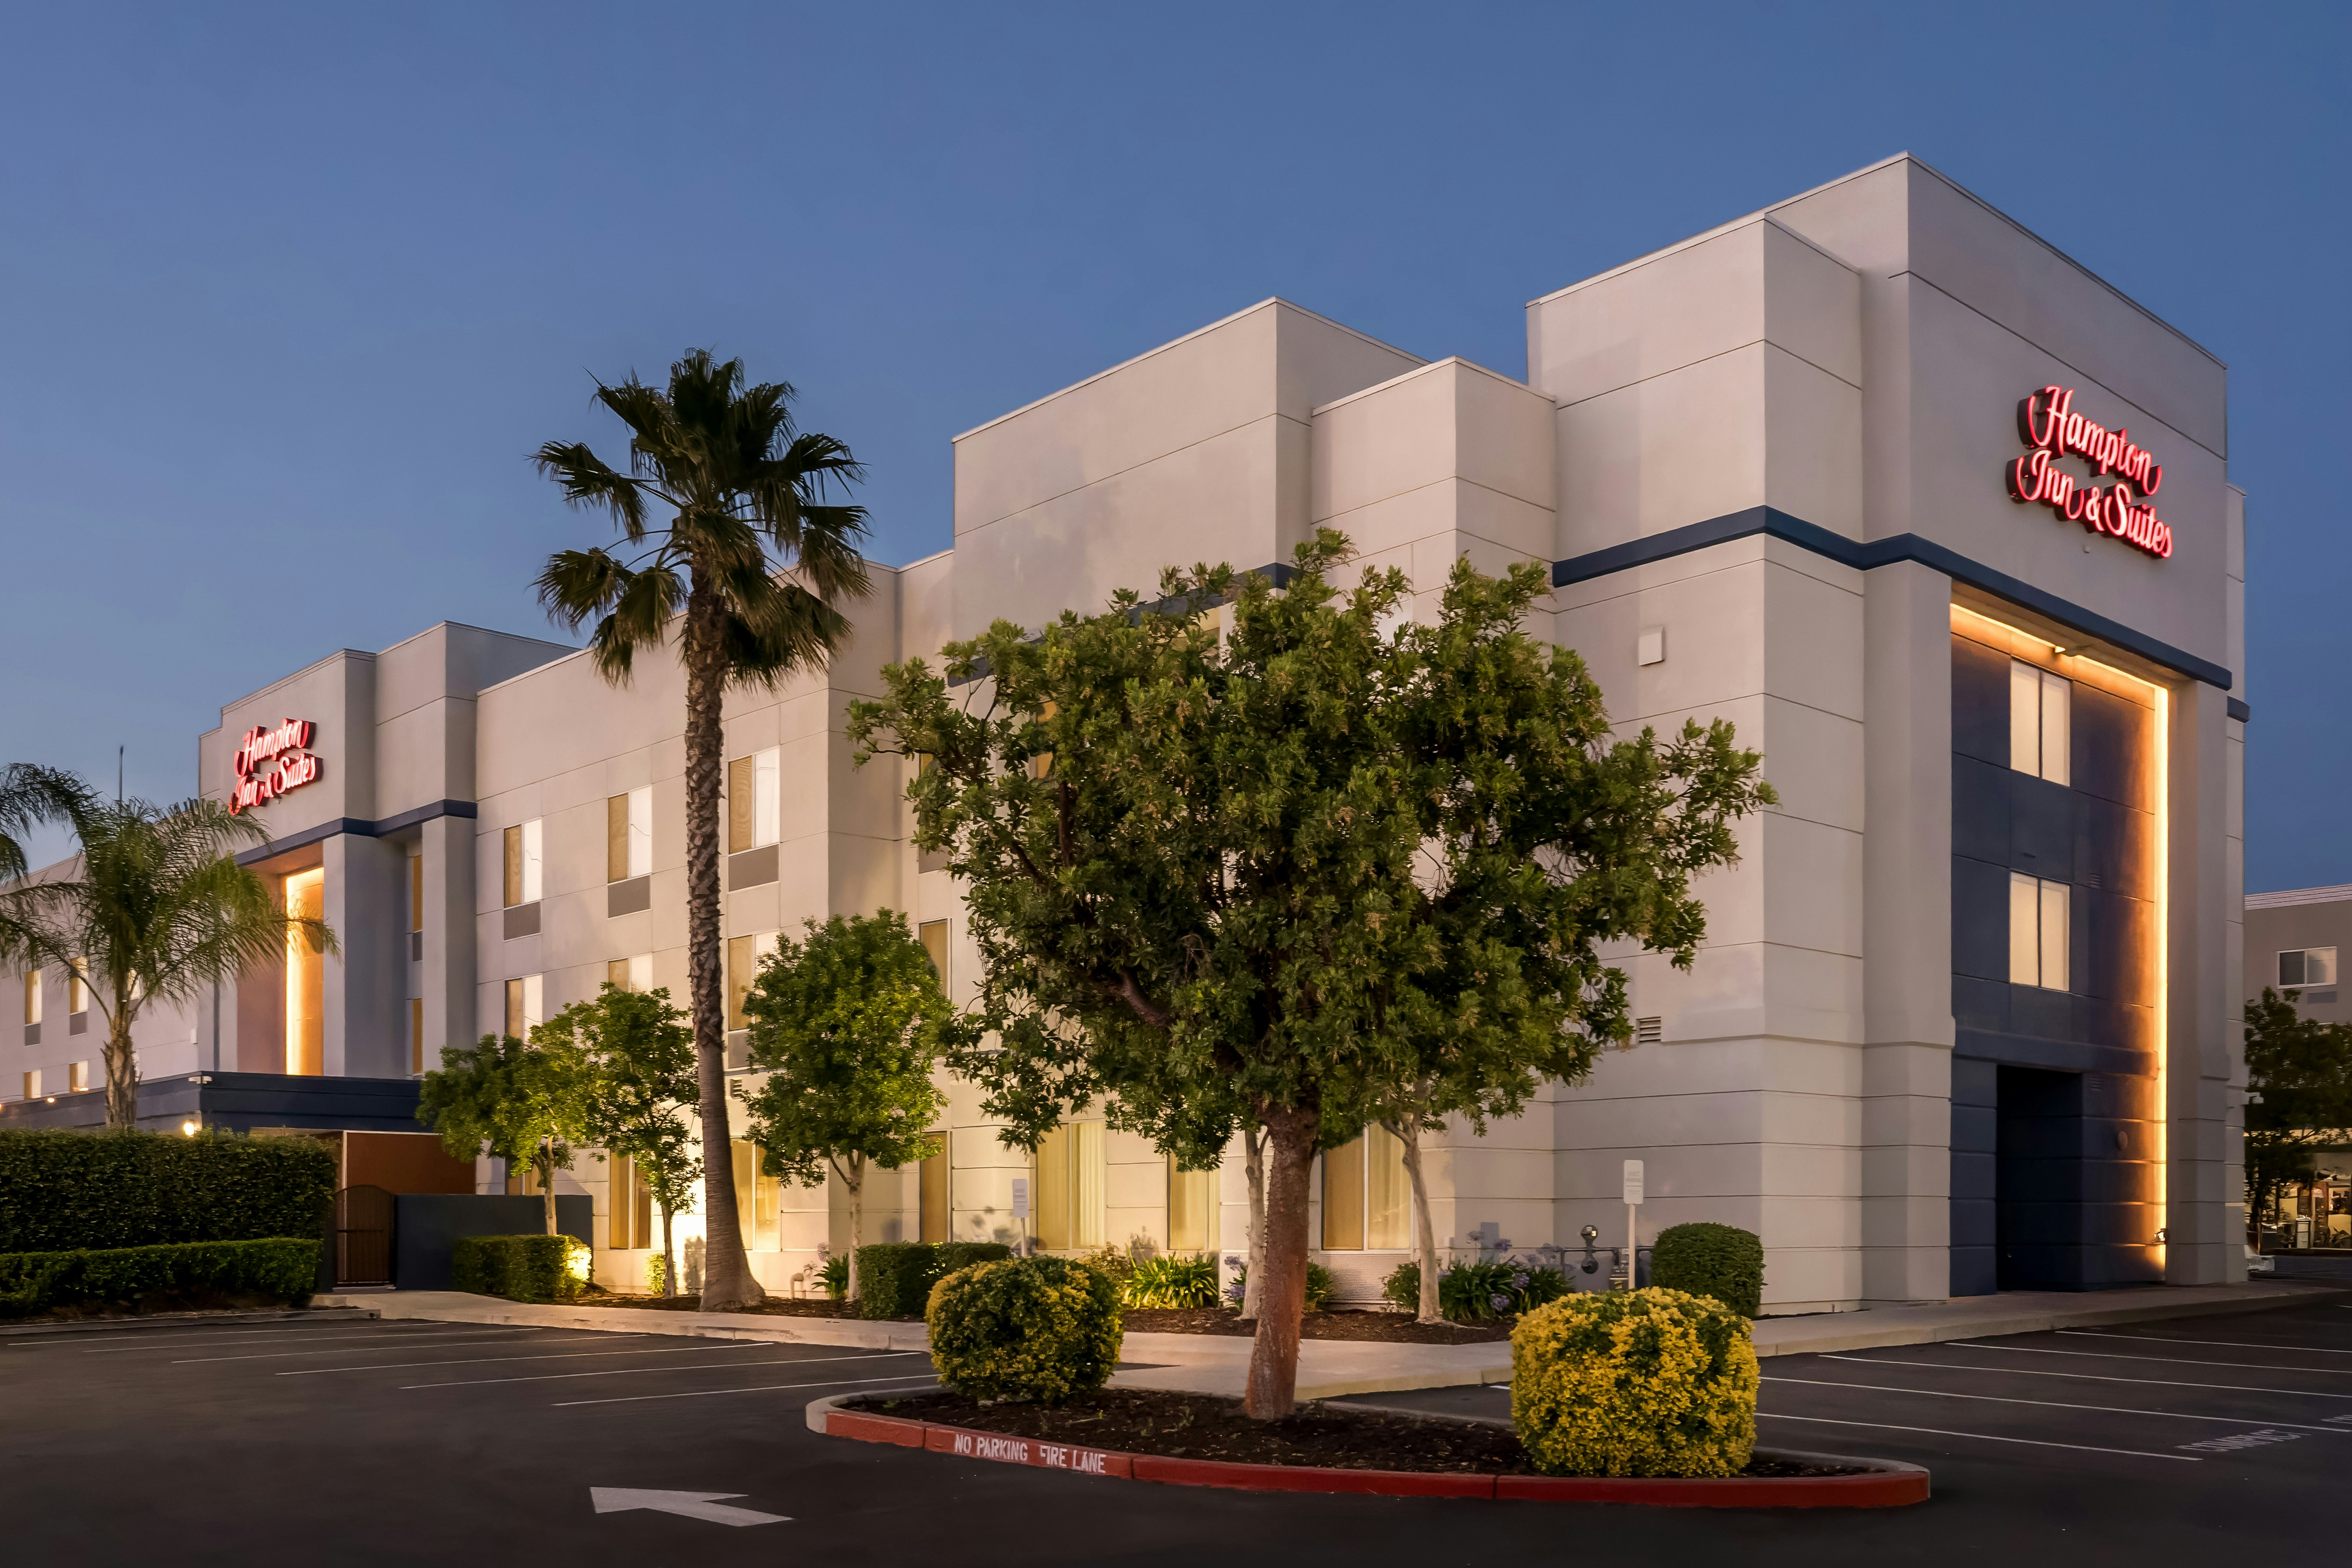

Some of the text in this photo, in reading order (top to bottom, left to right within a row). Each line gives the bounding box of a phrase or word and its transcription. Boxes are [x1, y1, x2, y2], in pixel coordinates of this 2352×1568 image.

[2027, 385, 2162, 496] Hampton
[2015, 450, 2173, 558] Inn & Suites
[233, 718, 309, 777] Hampton
[228, 775, 265, 816] Inn
[273, 753, 316, 794] Suites
[954, 1434, 1106, 1473] NO PARKING FIRE LANE
[2174, 1429, 2311, 1452] COMPACT
